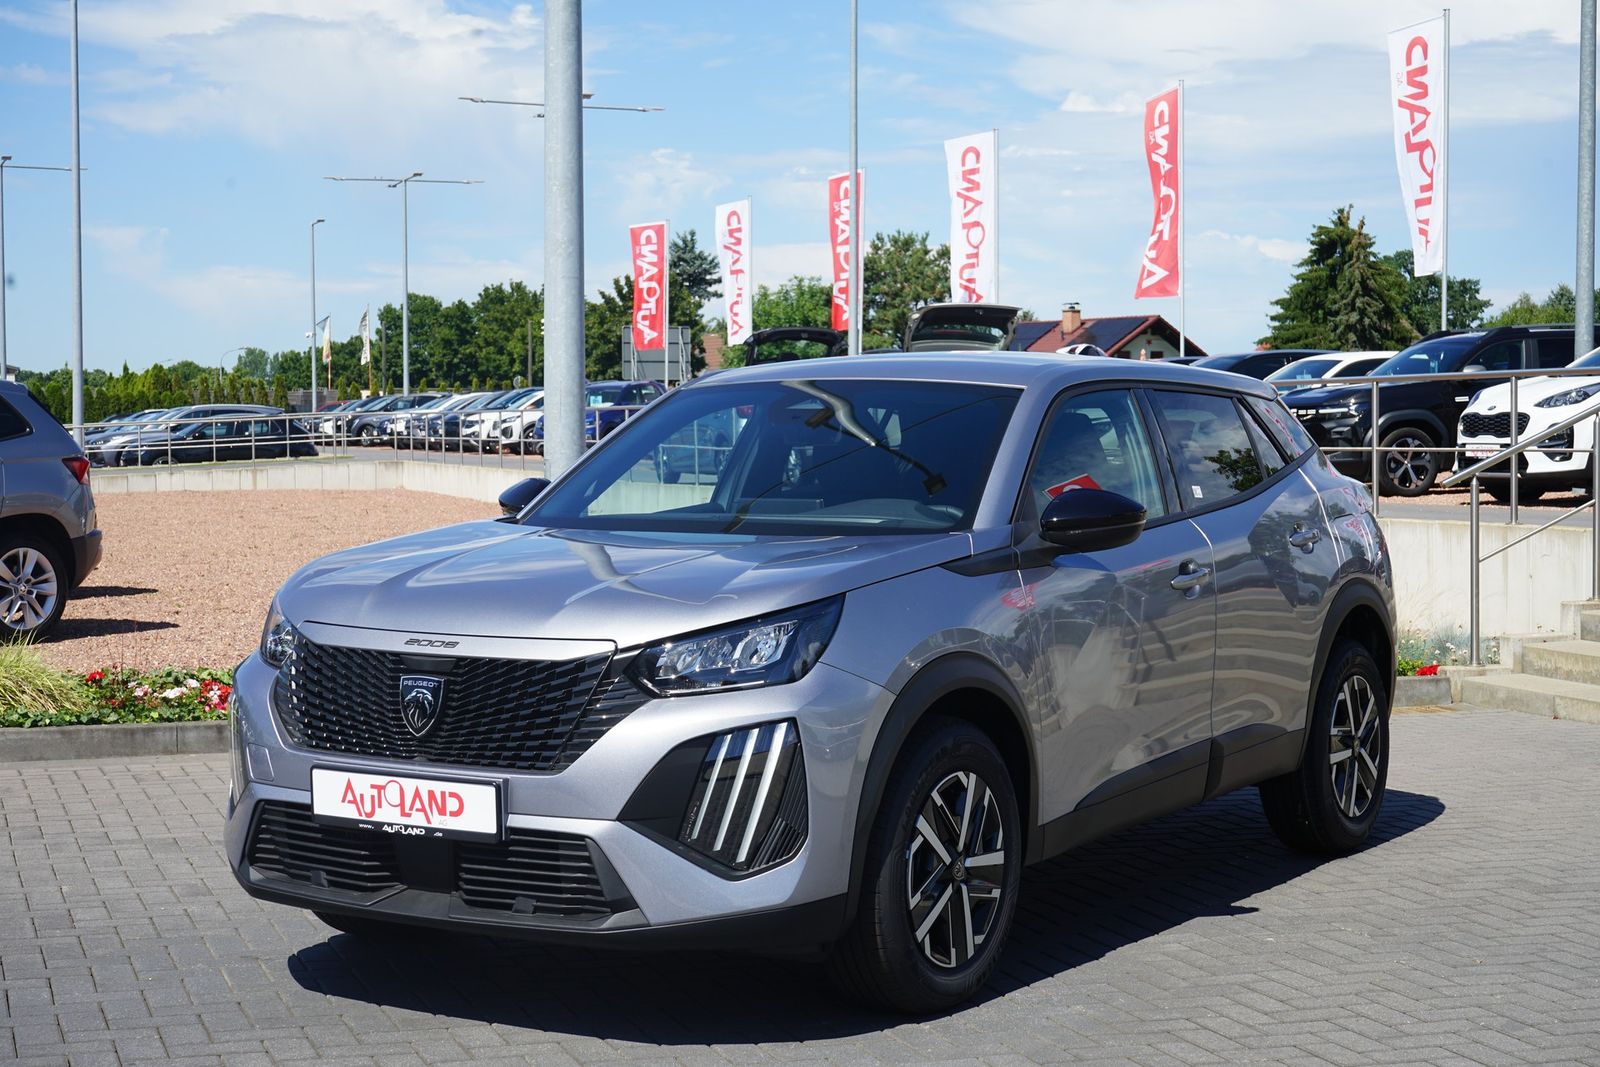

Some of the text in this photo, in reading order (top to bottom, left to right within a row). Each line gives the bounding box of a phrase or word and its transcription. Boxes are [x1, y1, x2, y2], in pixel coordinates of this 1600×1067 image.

[404, 638, 460, 649] 2008
[403, 680, 440, 688] PEUGEOT
[341, 777, 465, 825] AUTOLAND
[382, 824, 426, 836] AUTOLAND
